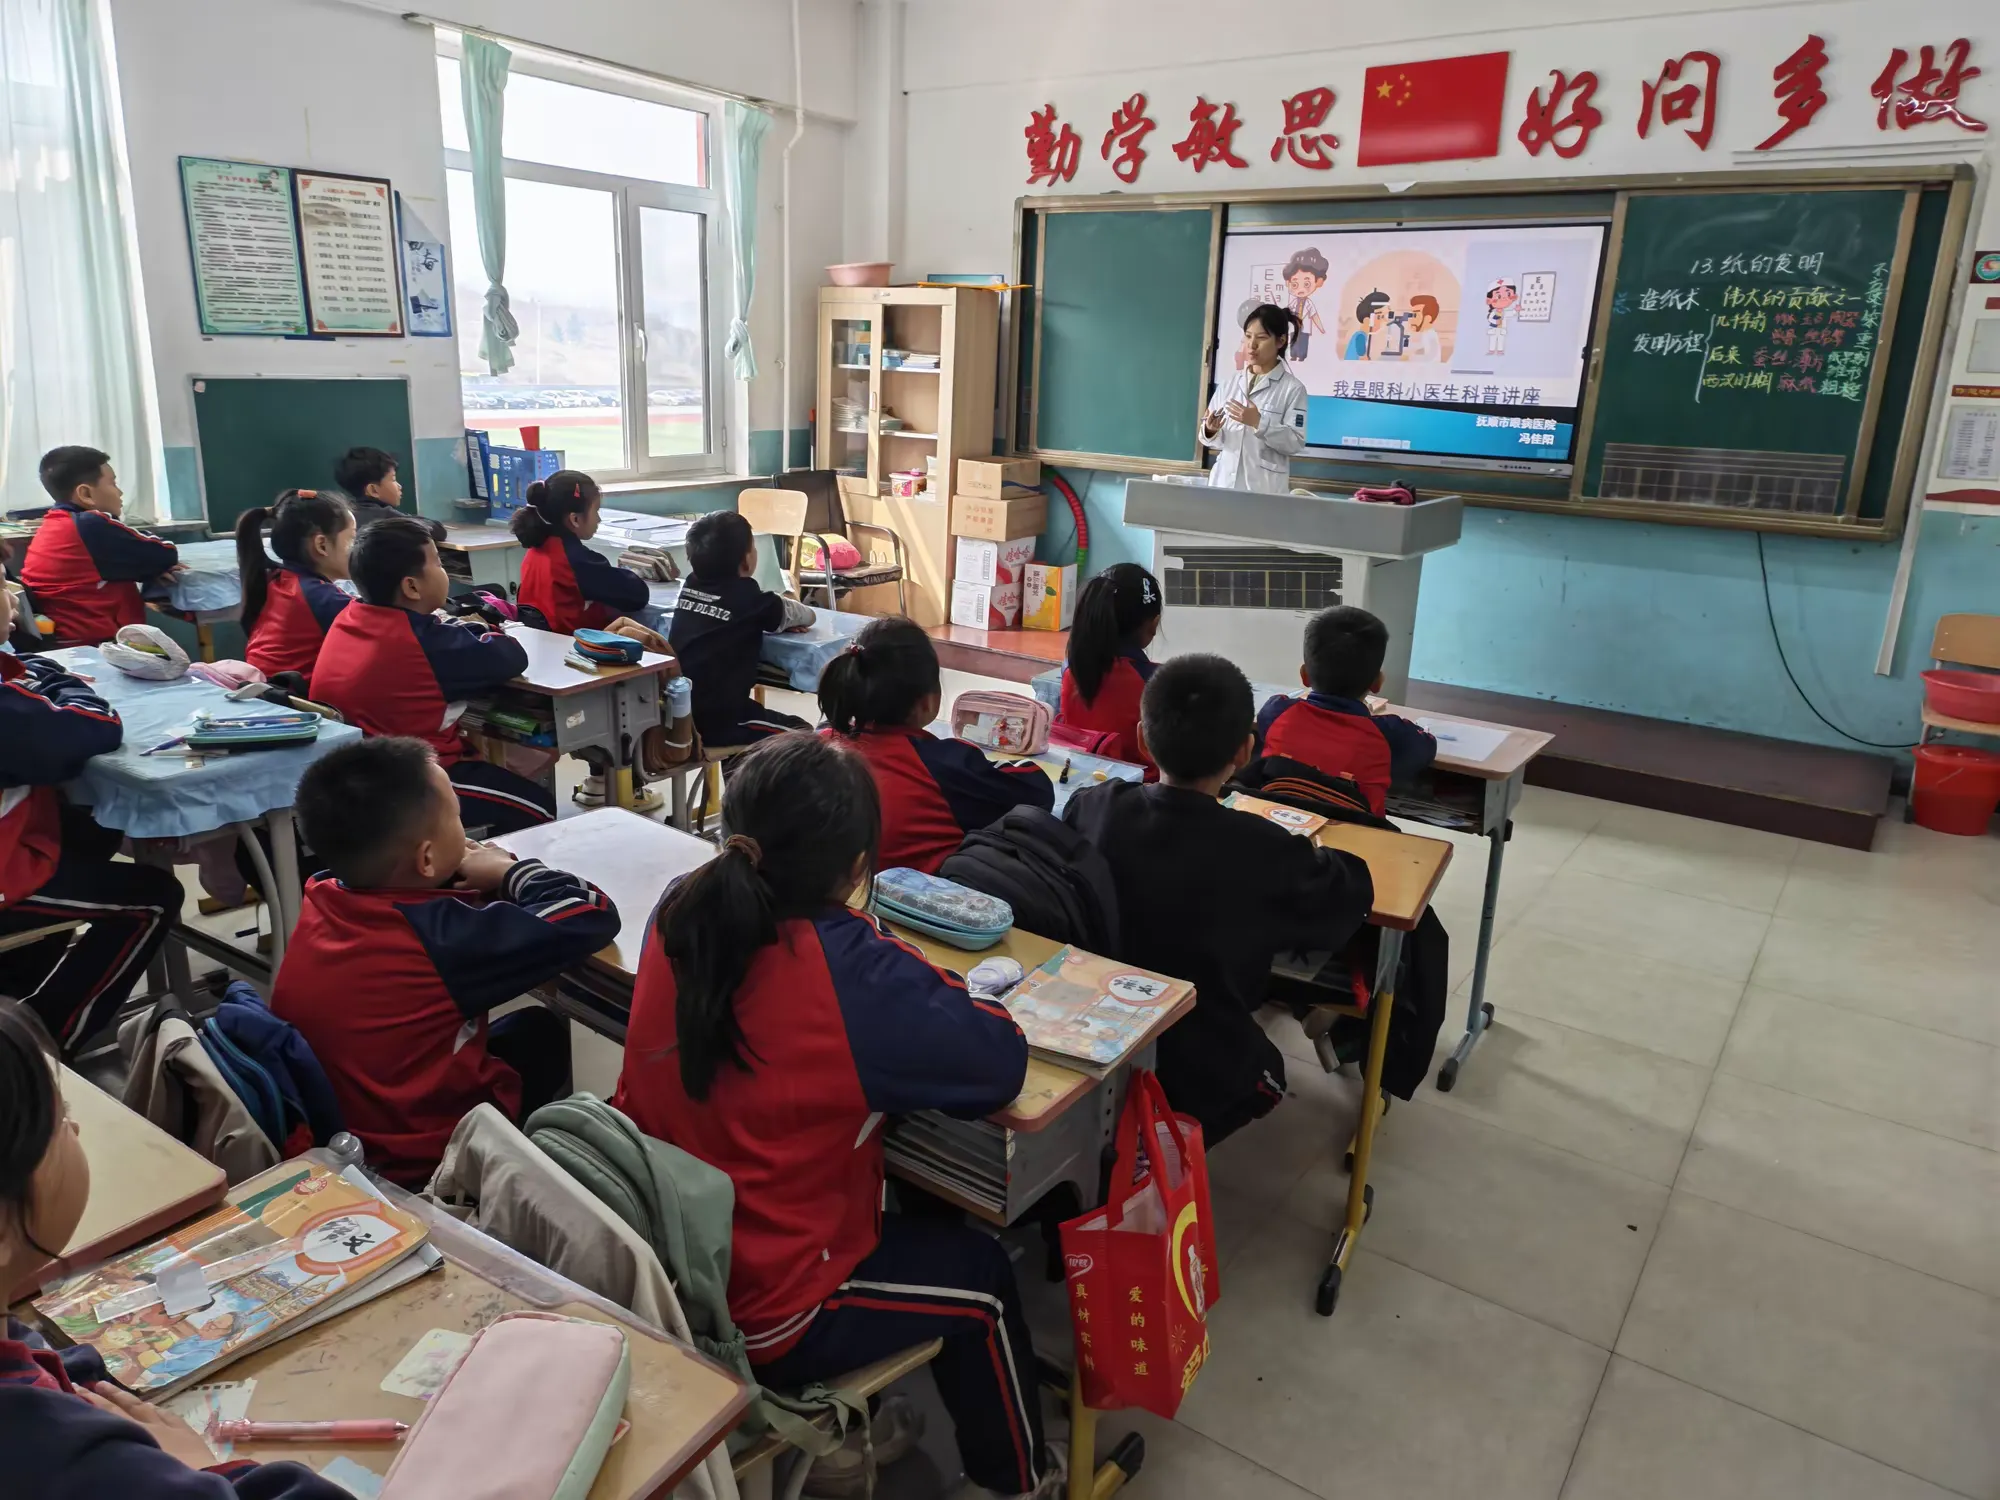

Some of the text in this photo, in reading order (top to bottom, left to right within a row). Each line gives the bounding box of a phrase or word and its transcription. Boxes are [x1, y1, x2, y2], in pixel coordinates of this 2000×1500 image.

[1025, 35, 1988, 187] 勤学敏思 好问多做
[1723, 285, 1861, 309] 伟大的贡献之一
[1633, 332, 1705, 356] 发明历程
[1707, 346, 1742, 365] 后来
[1333, 379, 1542, 406] 我是眼科小医生科普讲座
[1476, 415, 1556, 431] 抚顺市眼病医院
[1518, 432, 1555, 446] 冯佳阳
[1112, 976, 1159, 997] 语文
[318, 1216, 376, 1256] 语文
[1128, 1285, 1149, 1377] 爱的味道
